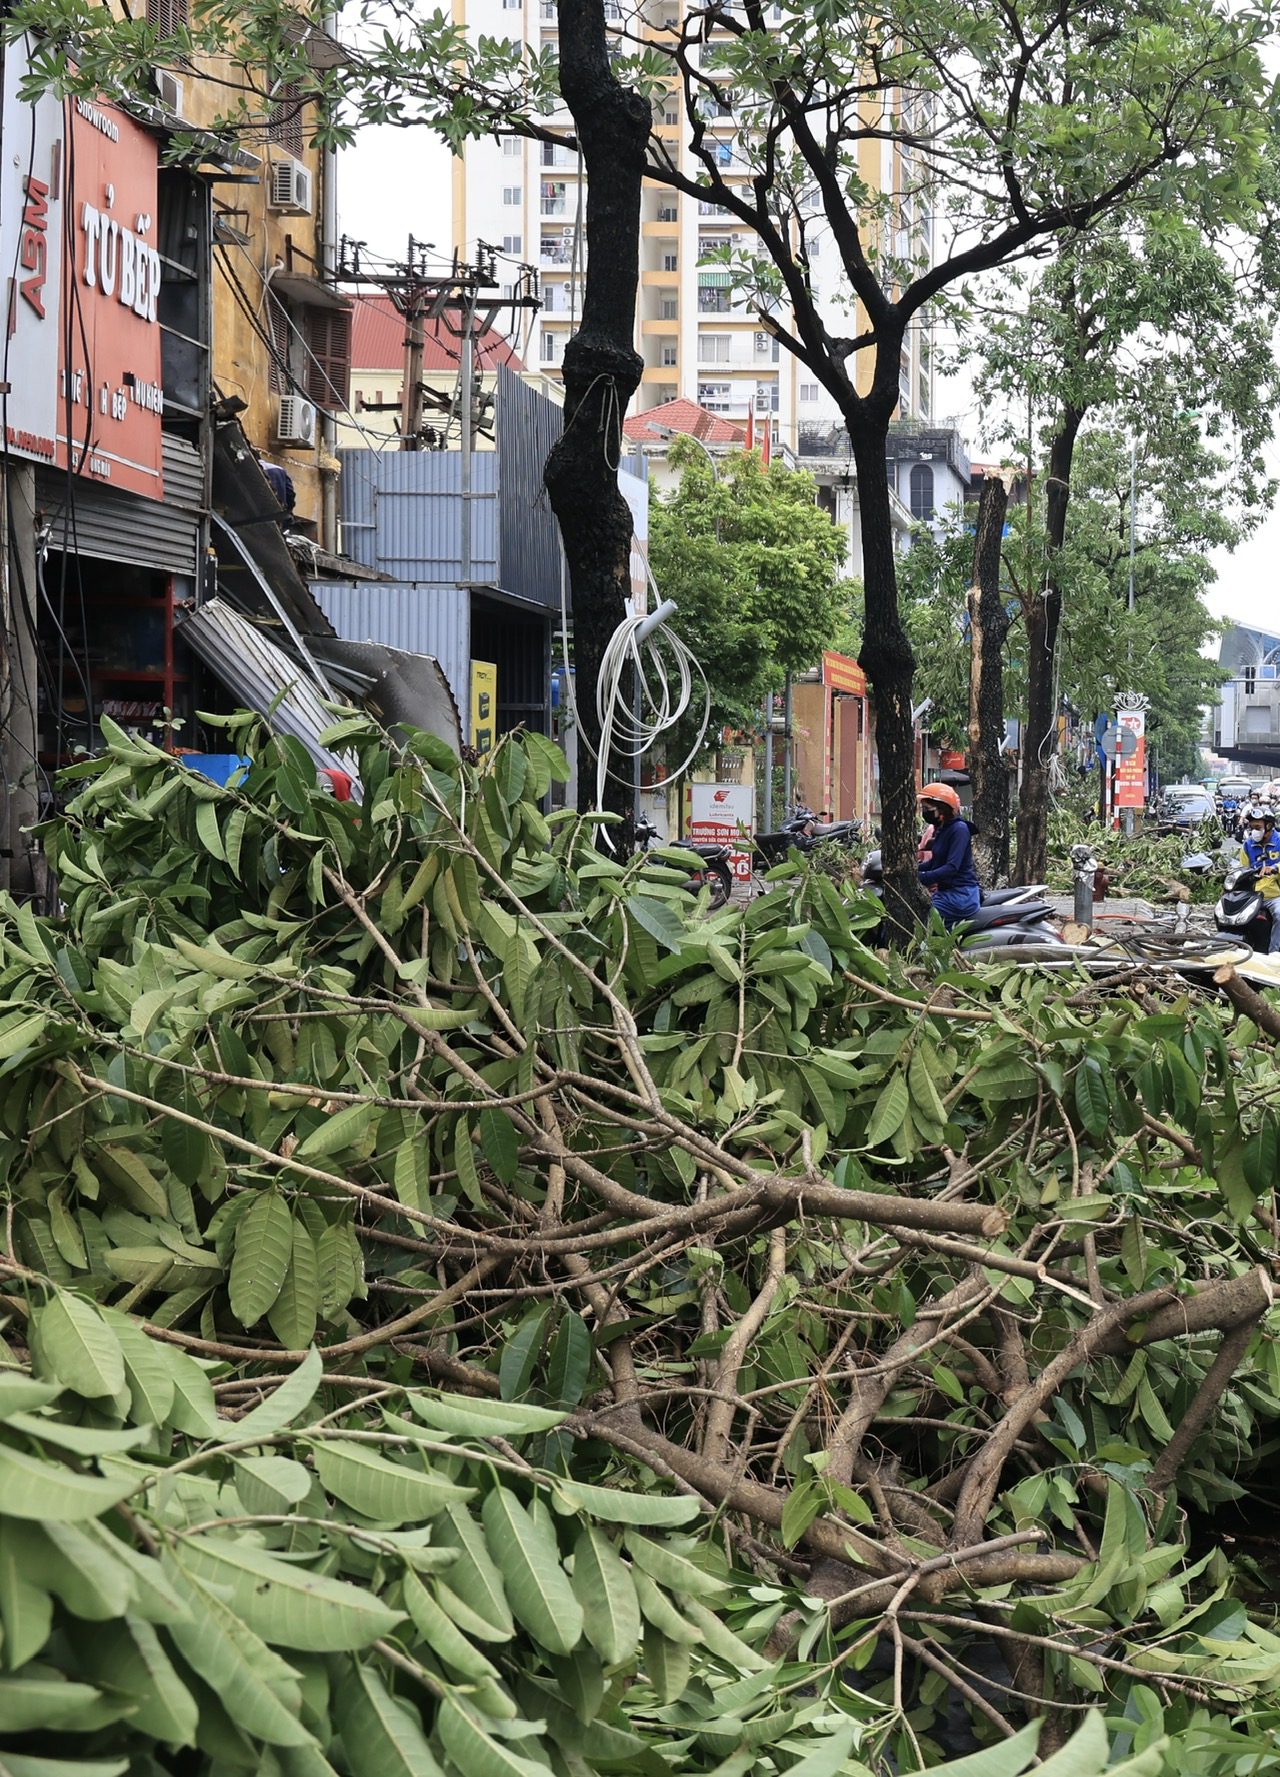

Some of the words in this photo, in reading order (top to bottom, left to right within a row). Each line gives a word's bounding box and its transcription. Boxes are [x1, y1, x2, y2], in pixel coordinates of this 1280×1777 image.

[77, 96, 119, 143] Showroom
[21, 174, 49, 320] ABM
[83, 184, 118, 296] TỦ
[119, 213, 161, 323] BẾP
[112, 387, 127, 421] BẾP
